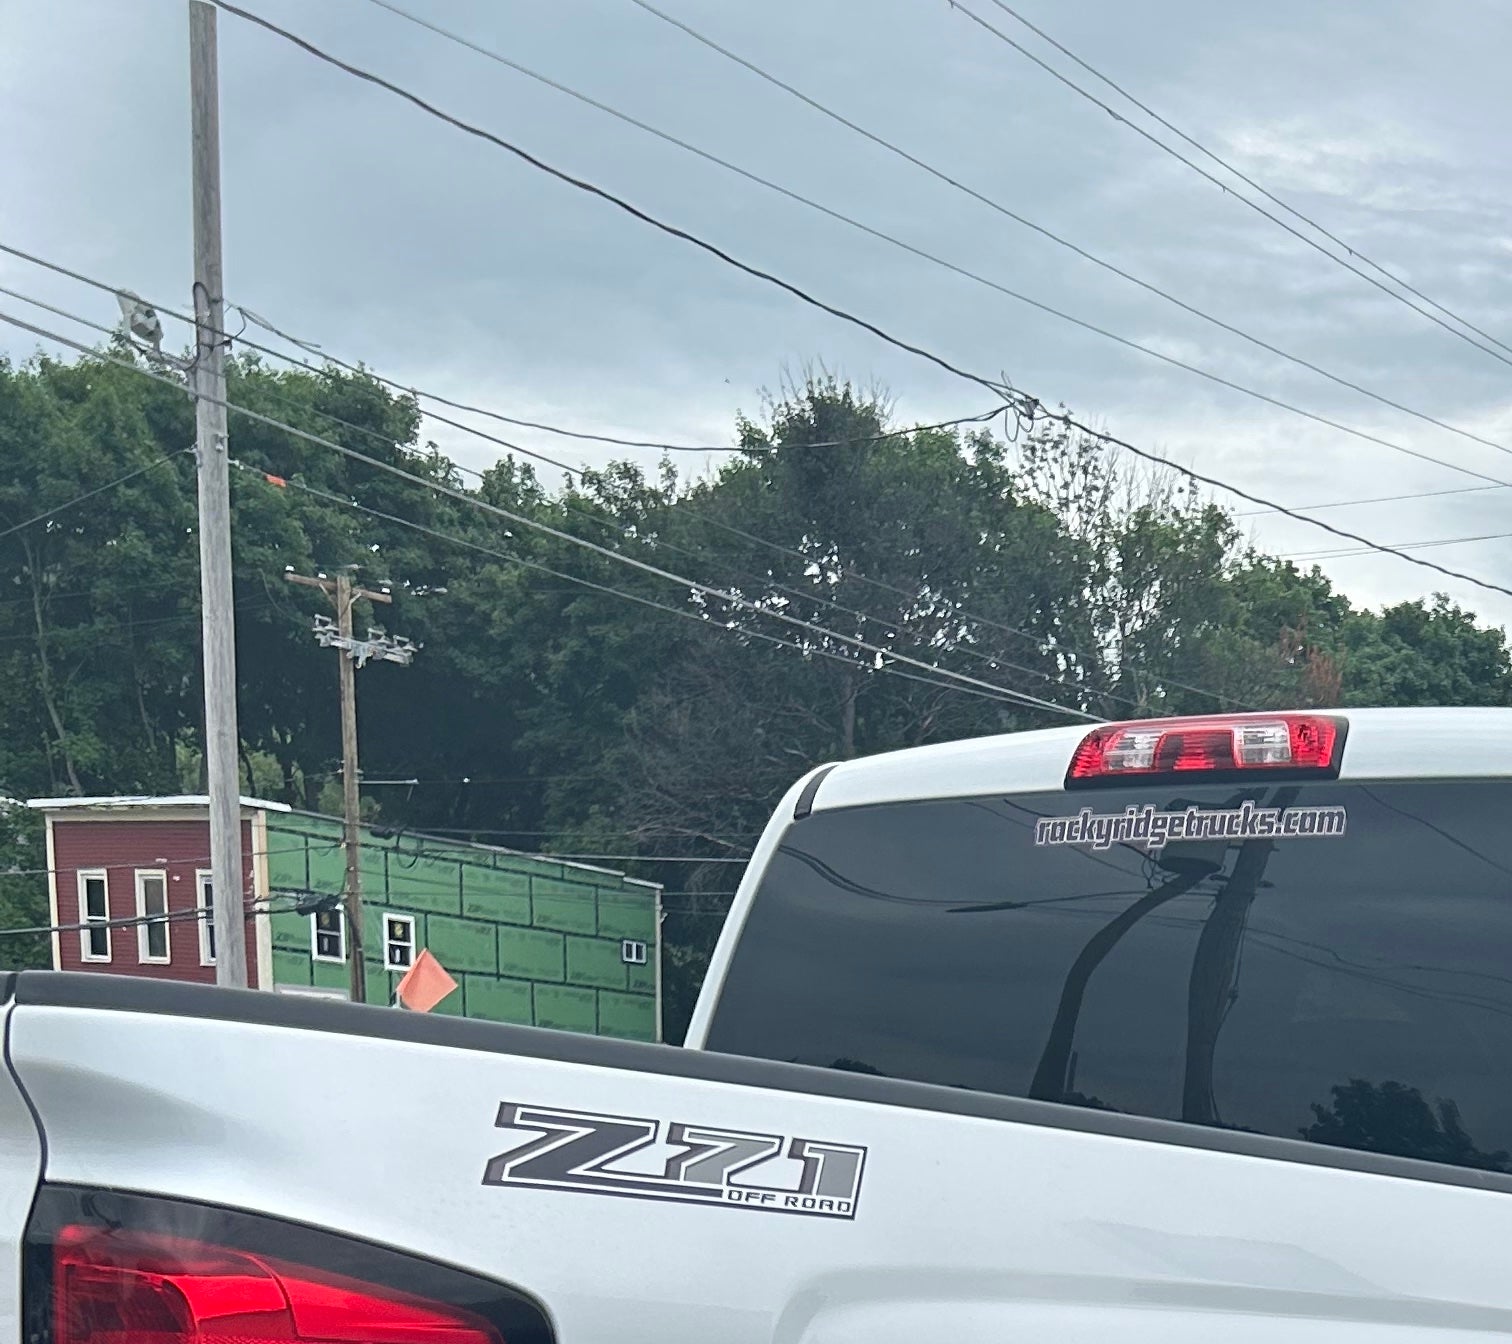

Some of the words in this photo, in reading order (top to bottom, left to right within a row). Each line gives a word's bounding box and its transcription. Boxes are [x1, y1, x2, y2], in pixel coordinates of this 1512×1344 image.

[1034, 801, 1348, 849] rockyridgetrucks.com
[481, 1101, 868, 1212] Z71
[728, 1190, 776, 1204] OFF
[784, 1195, 851, 1212] ROAD
